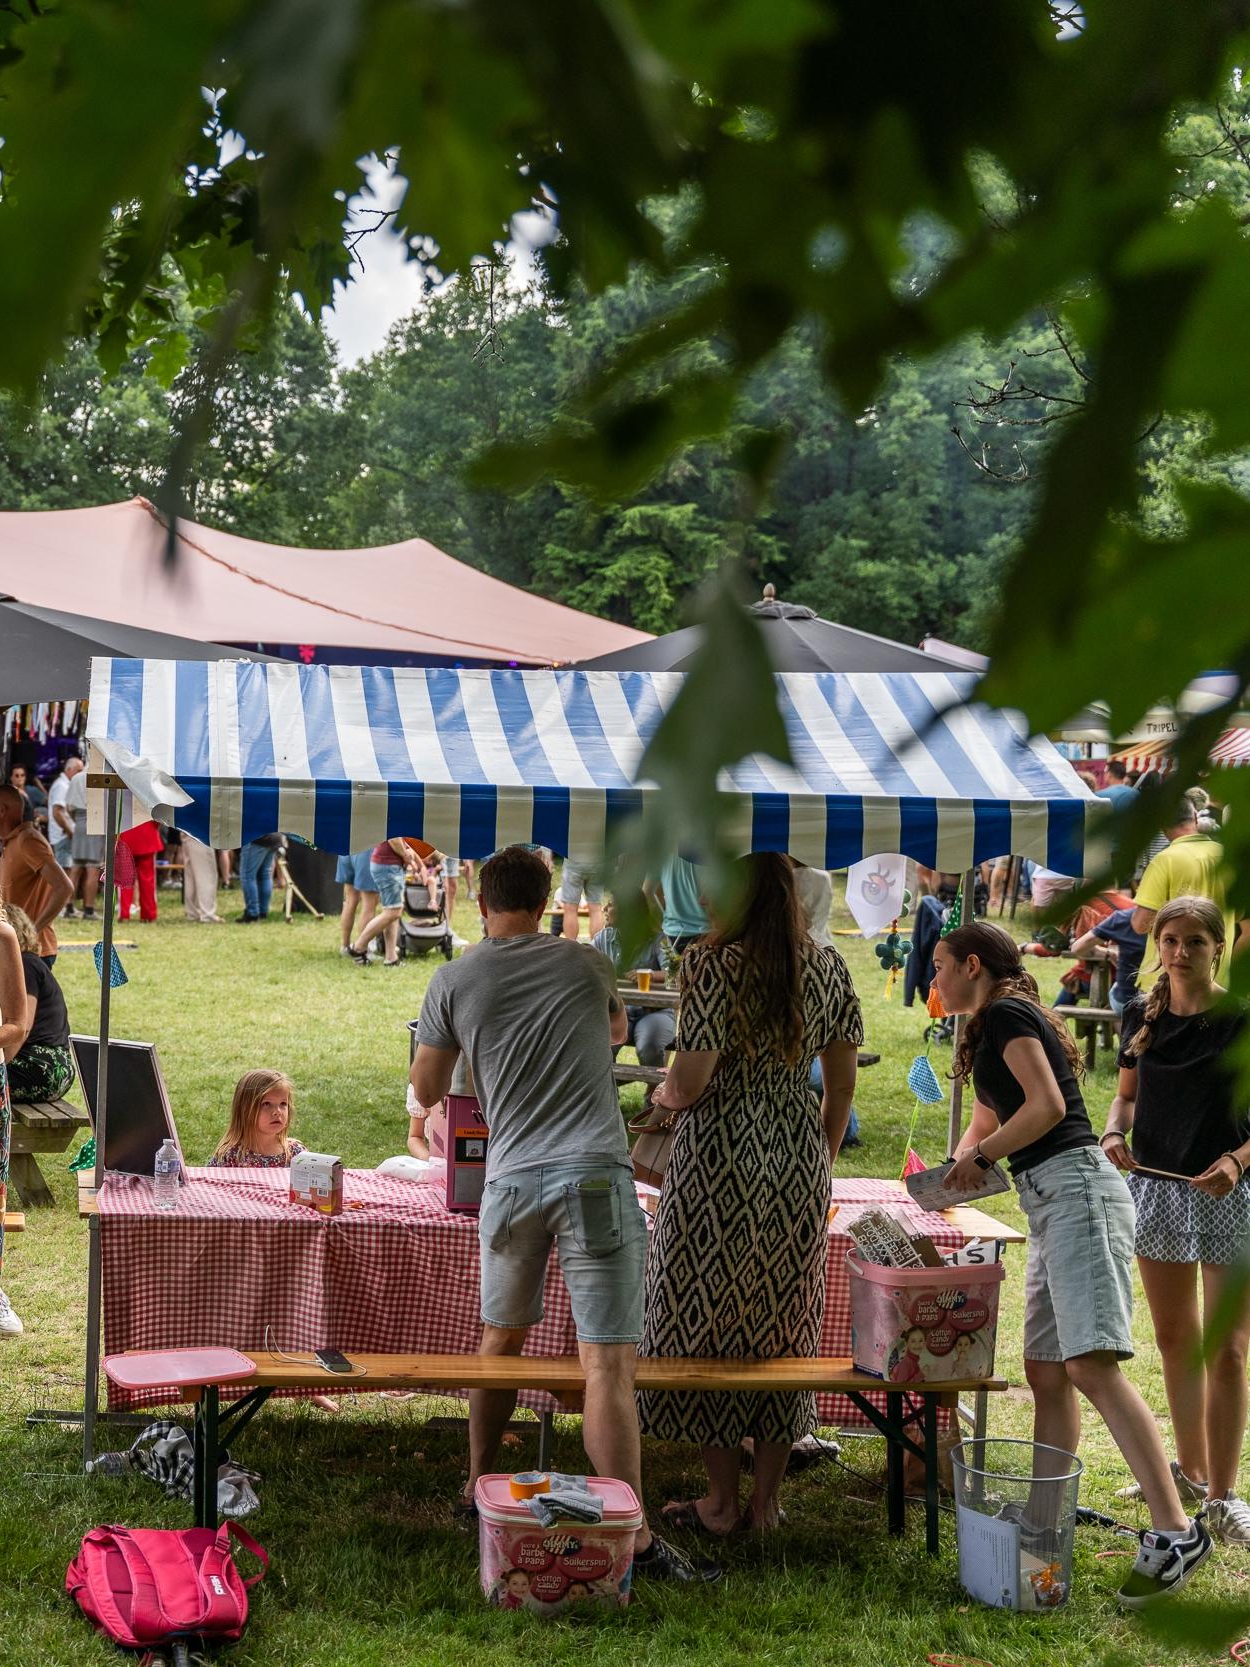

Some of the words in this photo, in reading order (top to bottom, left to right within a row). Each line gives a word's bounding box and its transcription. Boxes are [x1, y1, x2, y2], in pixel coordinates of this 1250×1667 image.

[1146, 722, 1178, 733] TRIPEL
[966, 1247, 984, 1264] S
[521, 1549, 545, 1557] barbe
[564, 1557, 606, 1566] Suikerspin
[536, 1574, 562, 1583] Cotton
